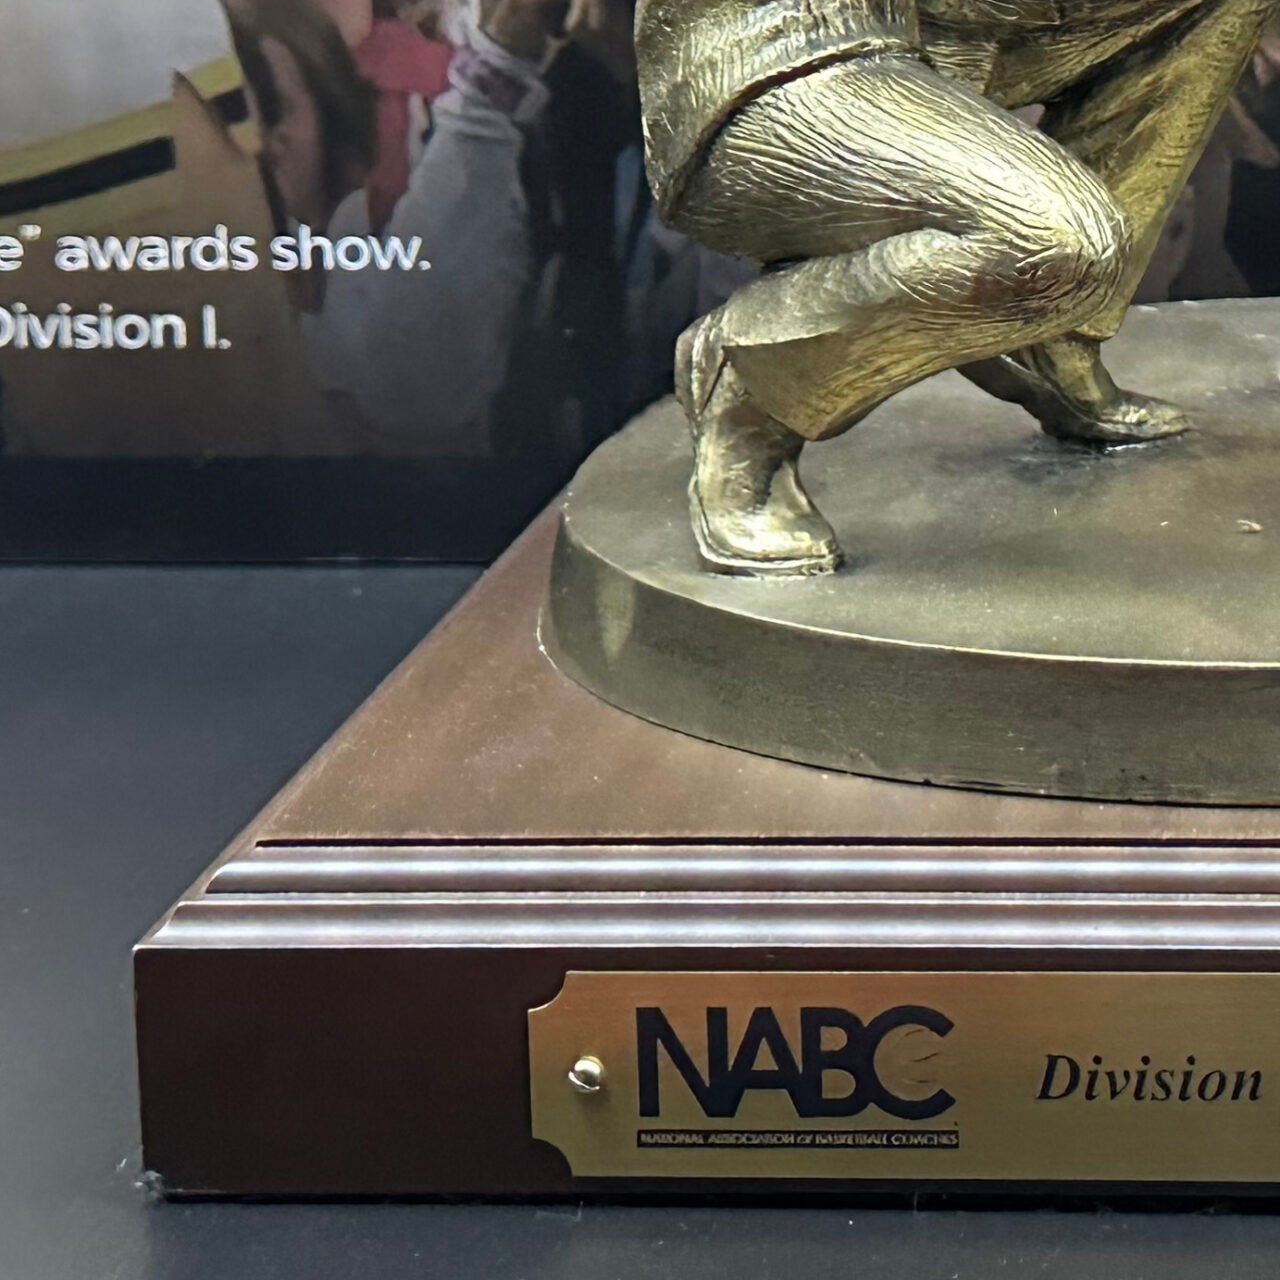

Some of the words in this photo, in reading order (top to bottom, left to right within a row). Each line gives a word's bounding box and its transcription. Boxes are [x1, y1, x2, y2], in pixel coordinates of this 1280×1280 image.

[54, 223, 260, 272] awards
[271, 223, 432, 272] show.
[636, 1005, 956, 1120] NABC
[1036, 1053, 1262, 1102] Division
